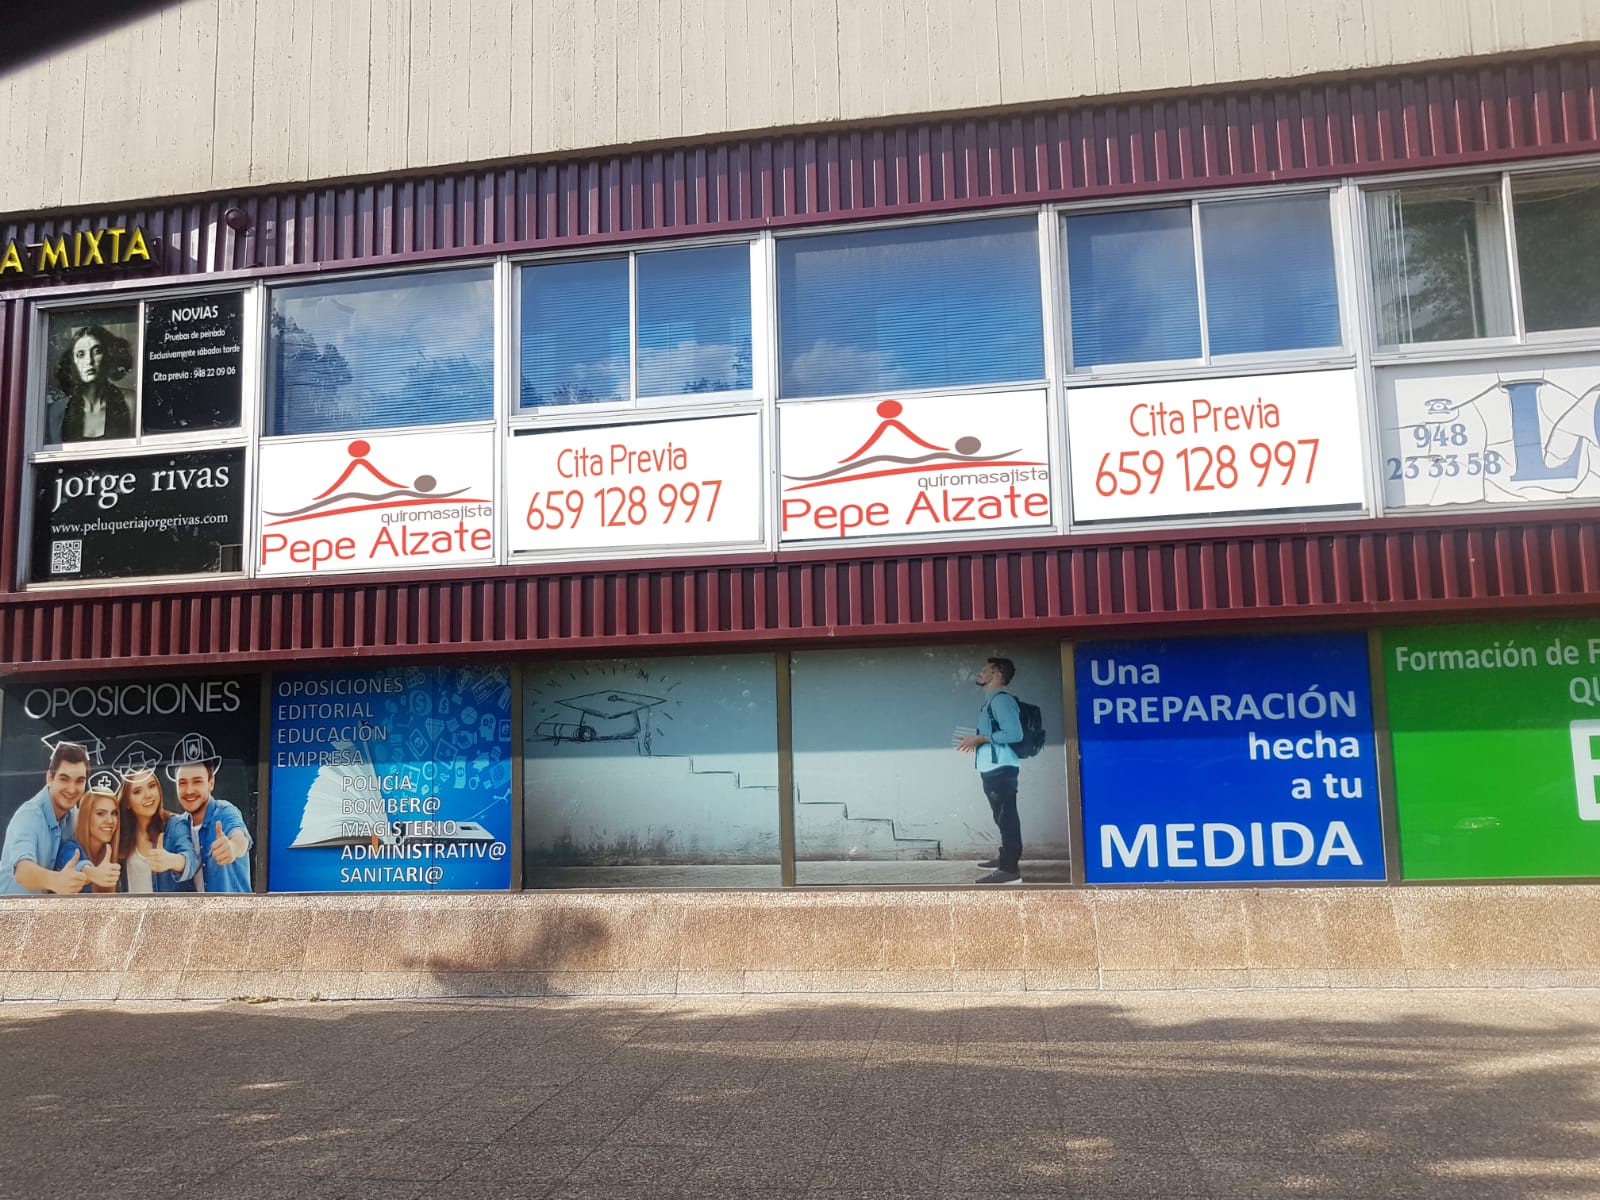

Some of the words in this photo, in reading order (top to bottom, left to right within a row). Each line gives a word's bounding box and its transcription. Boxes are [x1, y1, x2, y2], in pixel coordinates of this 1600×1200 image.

[38, 227, 150, 271] MIXTA
[171, 305, 219, 322] NOVIAS
[164, 332, 190, 342] Pruebas
[190, 330, 199, 339] de
[200, 327, 226, 339] peinado
[149, 349, 196, 361] Exclusivamente
[222, 343, 241, 353] tarde
[153, 371, 167, 382] Cita
[168, 370, 189, 382] previa
[193, 367, 206, 379] 948
[206, 367, 215, 377] 22
[216, 366, 226, 376] 09
[226, 365, 236, 375] 06
[1129, 402, 1185, 437] Cita
[1192, 397, 1280, 433] Previa
[1413, 423, 1468, 448] 948
[1501, 382, 1600, 482] L
[557, 447, 603, 479] Cita
[610, 442, 688, 475] Previa
[1096, 450, 1165, 497] 659
[1176, 444, 1238, 492] 128
[1249, 438, 1320, 487] 997
[1387, 457, 1420, 480] 23
[1428, 454, 1460, 477] 33
[1467, 450, 1501, 475] 58
[52, 468, 136, 513] jorge
[151, 460, 230, 492] rivas
[917, 466, 1049, 491] quiromasajista
[380, 502, 493, 526] quiromasajista
[526, 489, 585, 531] 659
[594, 484, 646, 527] 128
[657, 479, 723, 524] 997
[782, 498, 889, 538] Pepe
[905, 485, 1049, 526] Alzate
[52, 512, 228, 536] www.peluqueriajorgerivas.com
[261, 533, 356, 571] Pepe
[369, 520, 492, 559] Alzate
[1395, 640, 1538, 673] Formación
[1545, 638, 1580, 666] de
[1091, 657, 1161, 687] Una
[278, 676, 405, 698] OPOSICIONES
[24, 681, 241, 719] OPOSICIONES
[278, 701, 375, 721] EDITORIAL
[1093, 685, 1356, 725] PREPARACIÓN
[277, 720, 388, 744] EDUCACIÓN
[1249, 731, 1360, 761] hecha
[276, 750, 365, 768] EMPRESA
[342, 770, 413, 792] POLICÍA
[1291, 778, 1312, 799] a
[1323, 773, 1363, 799] tu
[341, 797, 441, 816] BOMBER@
[341, 819, 458, 838] MAGISTERIO
[340, 841, 508, 861] ADMINISTRATIV@
[1100, 821, 1364, 869] MEDIDA
[339, 866, 445, 885] SANITARI@
